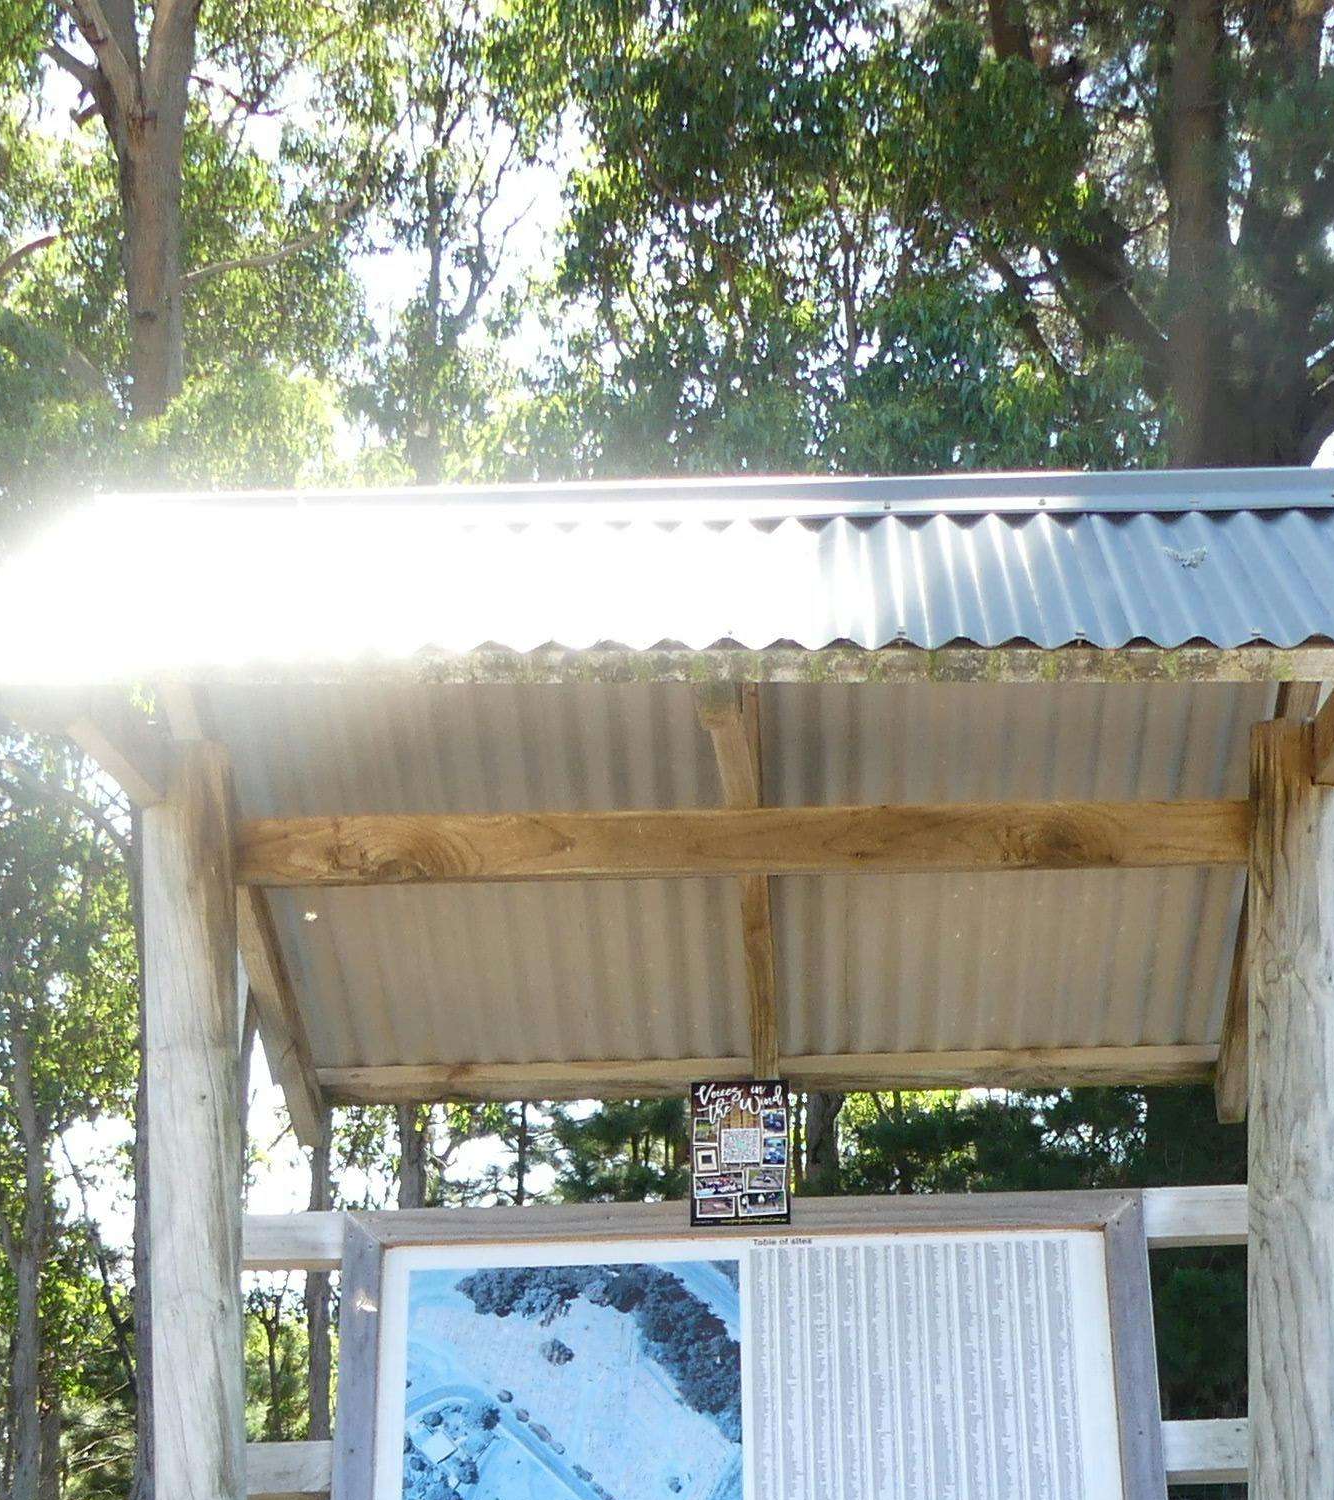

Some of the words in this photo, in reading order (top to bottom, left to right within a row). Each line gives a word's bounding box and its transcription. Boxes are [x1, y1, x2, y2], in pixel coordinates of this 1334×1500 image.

[695, 1083, 742, 1105] Voices
[750, 1085, 766, 1095] in
[697, 1097, 731, 1124] the
[739, 1085, 783, 1115] Wind
[753, 1238, 777, 1246] Table
[779, 1237, 788, 1245] of
[791, 1237, 812, 1245] sites
